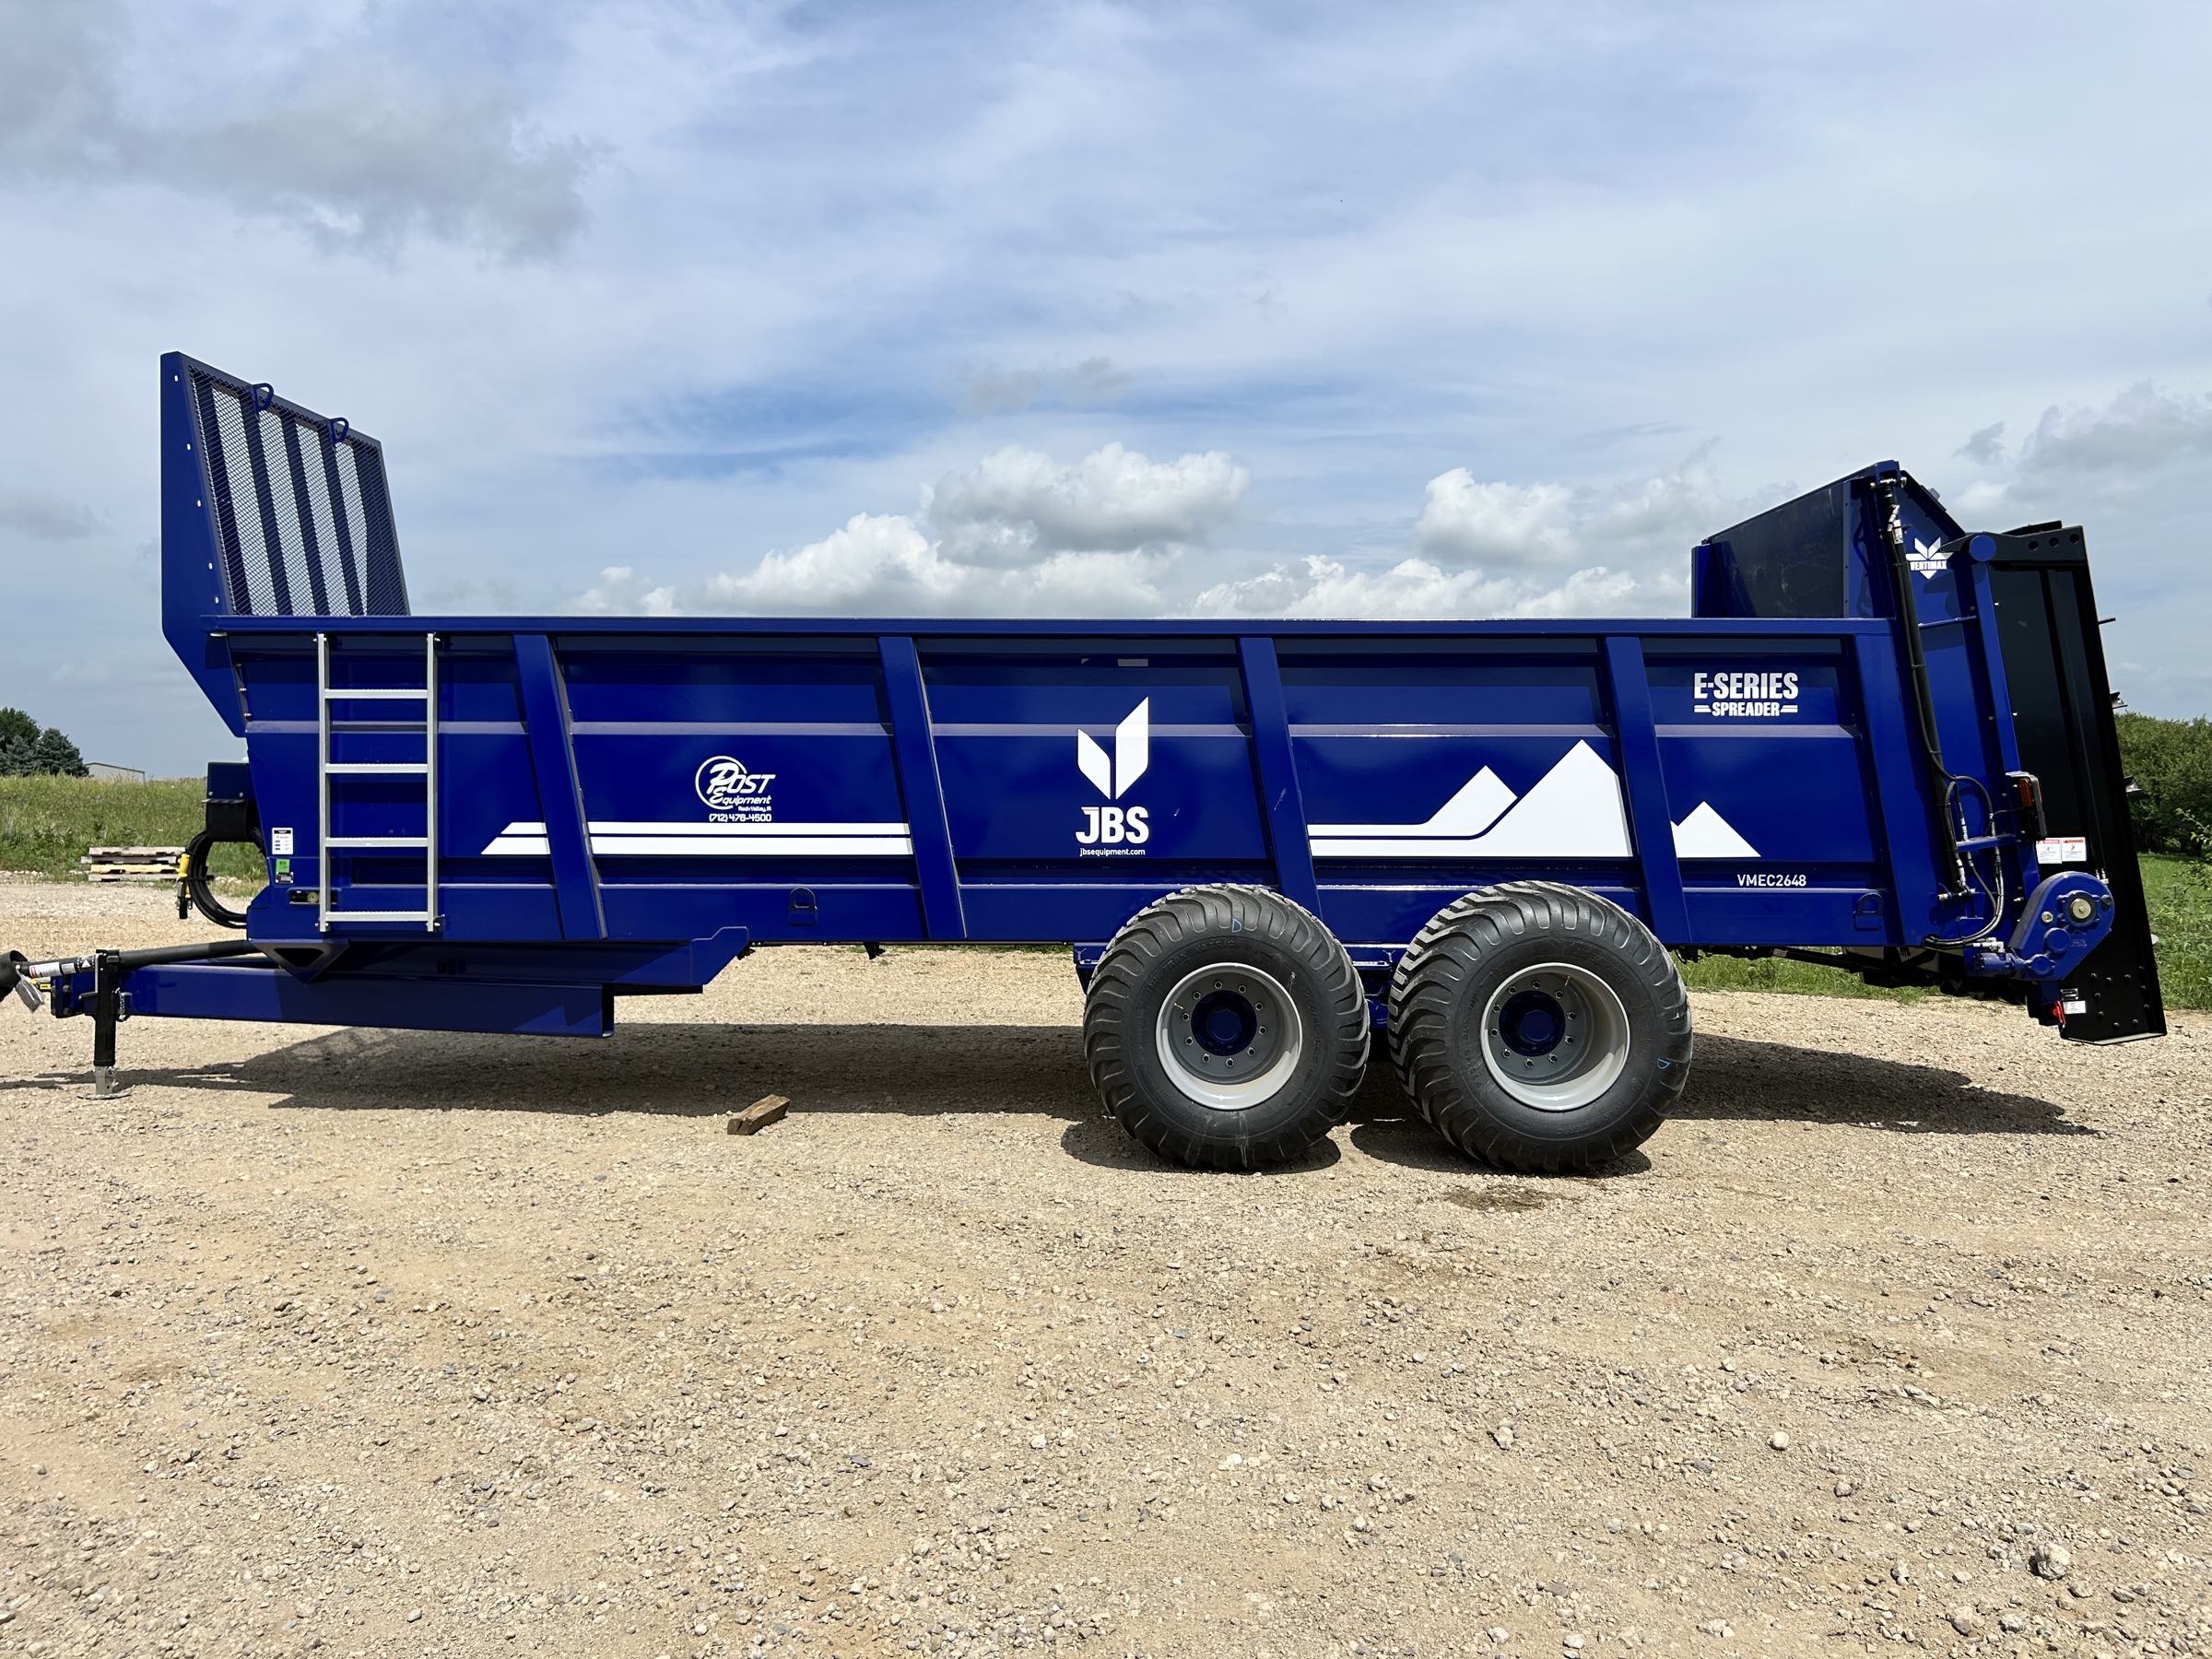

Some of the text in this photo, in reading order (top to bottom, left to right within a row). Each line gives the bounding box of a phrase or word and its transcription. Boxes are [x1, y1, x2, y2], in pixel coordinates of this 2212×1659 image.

[1694, 673, 1799, 700] E-SERIES
[1712, 702, 1781, 717] SPREADER
[709, 813, 728, 823] (712)
[1075, 806, 1149, 844] JBS
[1079, 848, 1146, 857] jbsequipment.com
[1736, 874, 1806, 887] VMEC2648
